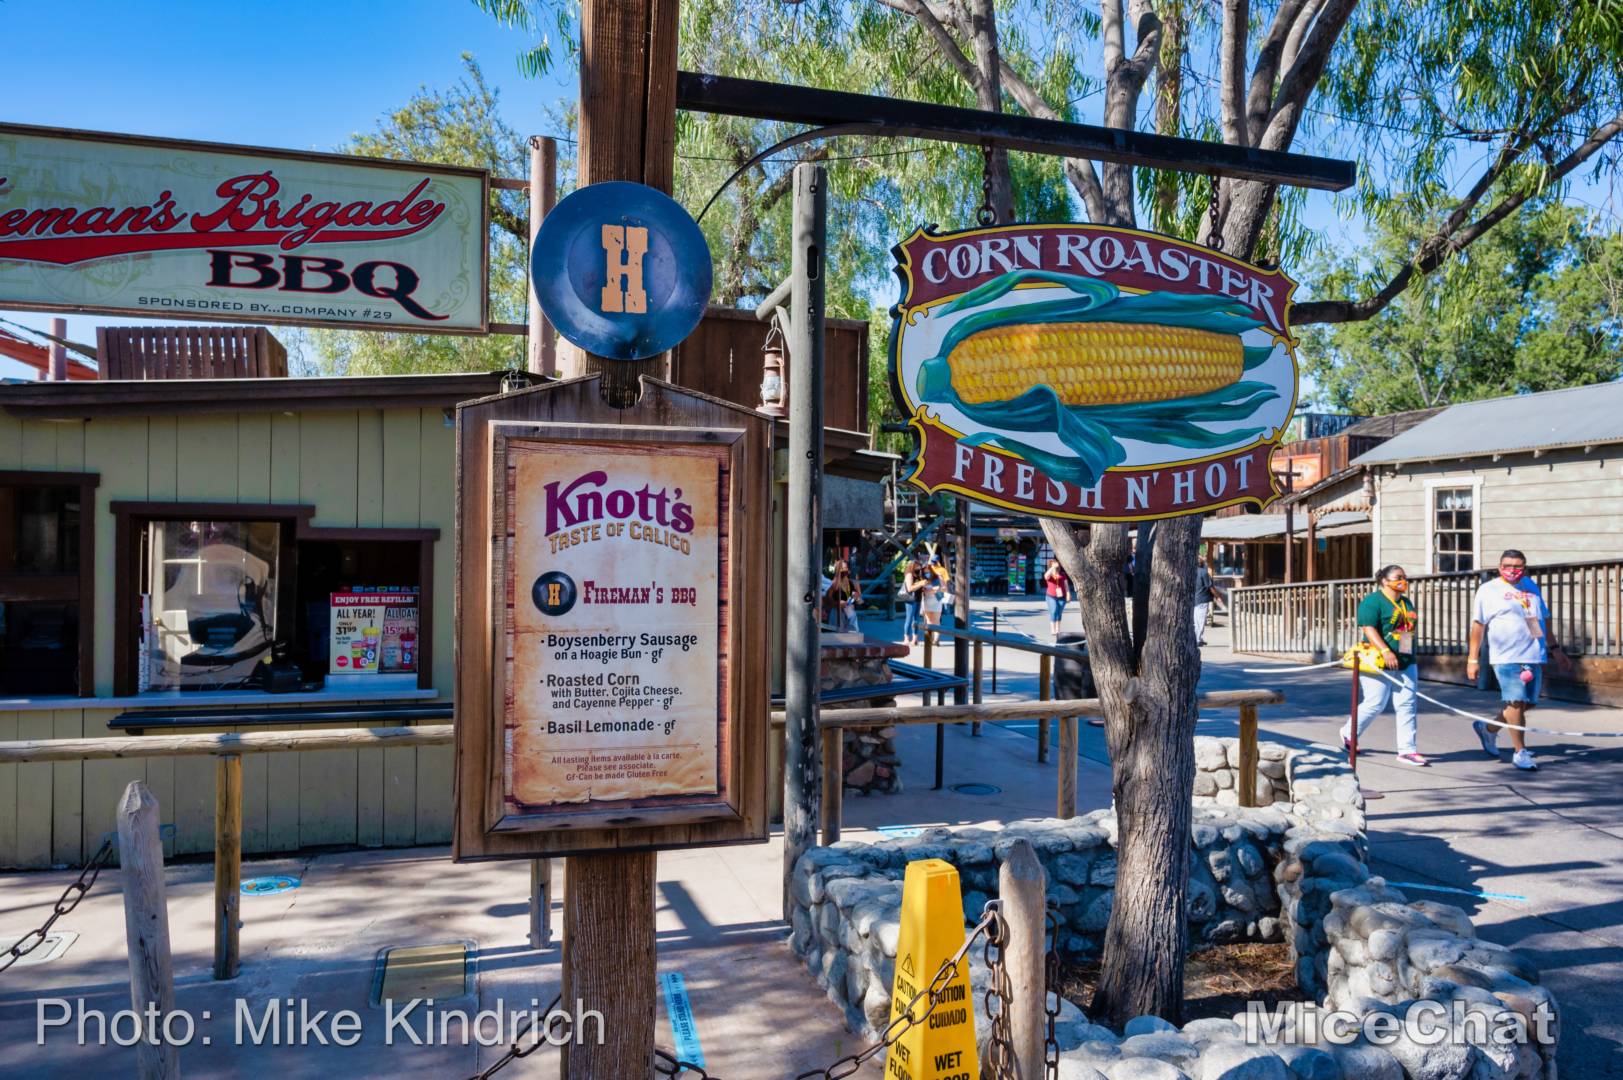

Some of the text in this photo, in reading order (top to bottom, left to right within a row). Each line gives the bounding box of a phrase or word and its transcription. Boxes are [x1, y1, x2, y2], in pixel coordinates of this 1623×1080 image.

[191, 170, 446, 251] Brigade
[601, 223, 649, 314] H
[206, 249, 449, 321] BBQ
[921, 234, 1286, 332] CORN ROASTER
[138, 296, 243, 311] SPONSORED
[362, 307, 392, 320] #29
[951, 442, 1105, 509] FRESH
[544, 470, 695, 537] Knott's
[549, 520, 691, 555] TASTE OF CALICO
[335, 596, 359, 605] ENJOY
[360, 596, 380, 604] FREE
[336, 608, 375, 619] ALL YEAR!
[387, 608, 399, 618] ALL
[547, 633, 698, 651] Boysenberry Sausage
[554, 651, 568, 660] on
[571, 652, 577, 660] a
[580, 650, 618, 664] Hoagie
[621, 649, 641, 659] Bun
[651, 648, 663, 663] gf
[547, 673, 640, 687] Roasted Corn
[551, 687, 571, 697] with
[612, 686, 640, 699] Cojita
[552, 699, 571, 709] and
[573, 698, 616, 711] Cayenne
[619, 697, 654, 709] Pepper
[663, 696, 674, 710] gf
[547, 720, 582, 734] Basil
[585, 718, 654, 733] Lemonade
[664, 719, 676, 735] gf
[551, 756, 562, 764] All
[563, 756, 589, 766] tasting
[590, 755, 611, 763] items
[613, 753, 645, 762] available
[576, 763, 601, 772] Please
[594, 772, 603, 780] be
[605, 771, 625, 779] made
[626, 770, 651, 778] Gluten
[652, 769, 668, 777] Free
[929, 1008, 966, 1030] CUIDADO
[896, 1040, 910, 1065] WET
[934, 1051, 963, 1072] WET
